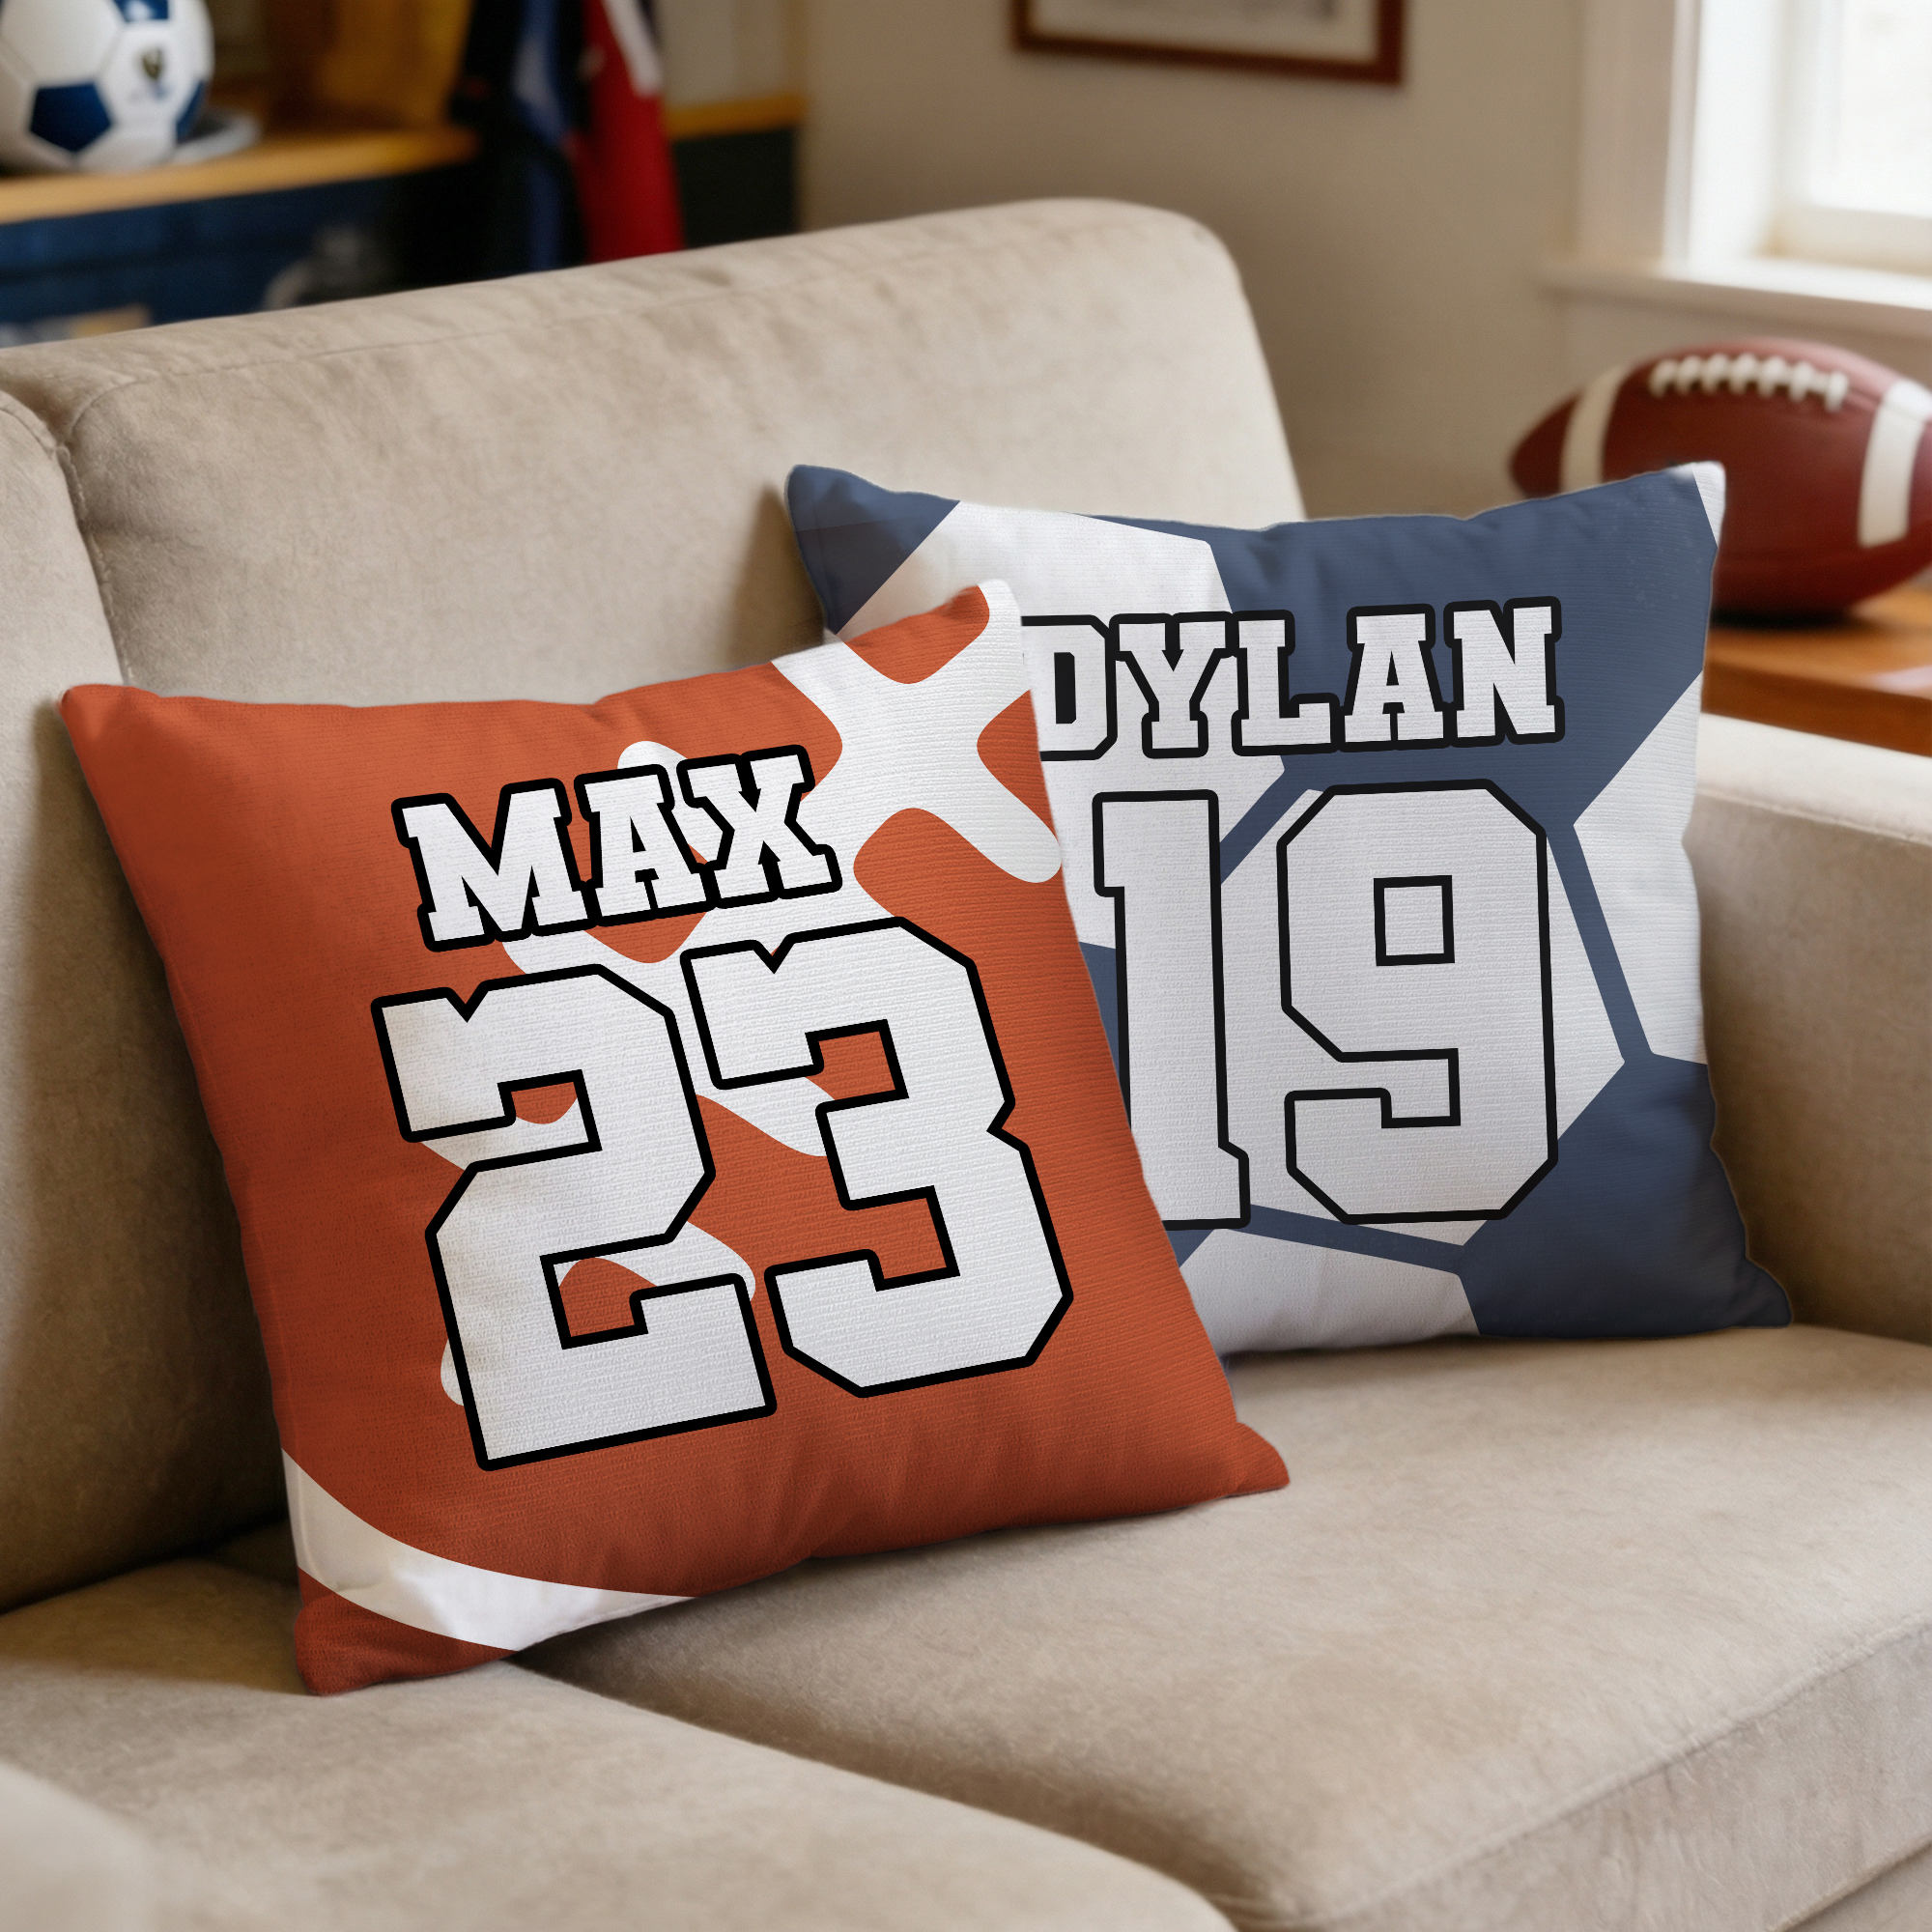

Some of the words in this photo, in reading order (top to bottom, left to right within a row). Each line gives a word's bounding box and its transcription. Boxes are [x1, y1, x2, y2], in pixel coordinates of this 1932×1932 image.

[1021, 596, 1565, 760] DYLAN
[391, 744, 842, 952] MAX
[1092, 779, 1558, 1230] 19
[371, 916, 1074, 1471] 23
